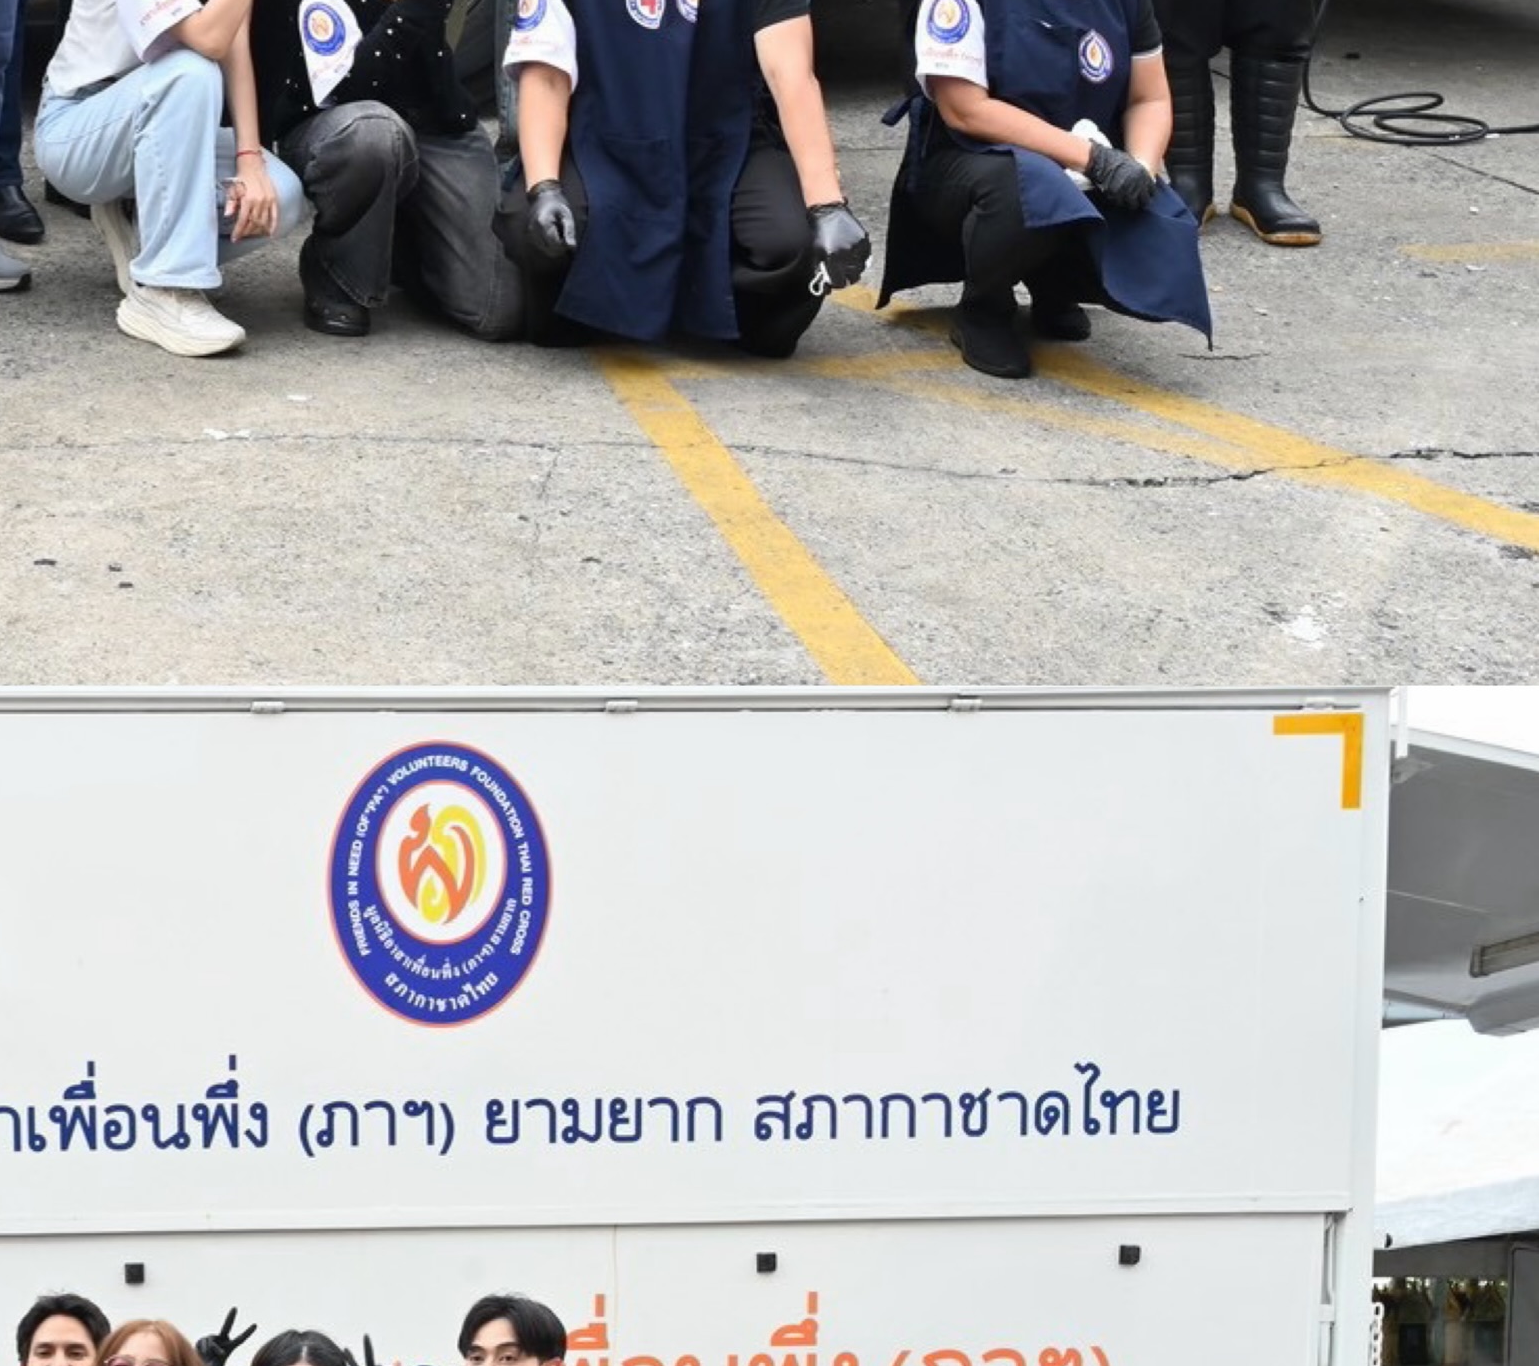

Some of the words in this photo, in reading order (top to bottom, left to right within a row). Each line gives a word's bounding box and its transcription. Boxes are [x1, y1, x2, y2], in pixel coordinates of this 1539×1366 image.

[387, 755, 469, 786] VOLUNTEERS
[470, 765, 524, 839] FOUNDATION
[347, 839, 363, 877] NEED
[517, 841, 533, 873] THAI
[347, 880, 359, 896] IN
[521, 876, 534, 906] RED
[348, 899, 372, 956] FRIENDS
[509, 909, 531, 956] CROSS
[384, 971, 500, 1012] สภากาชาดไทย
[299, 1099, 455, 1156] (ภาฯ)
[484, 1095, 723, 1145] ยามยาก
[753, 1062, 1181, 1142] สภากาชาดไทย
